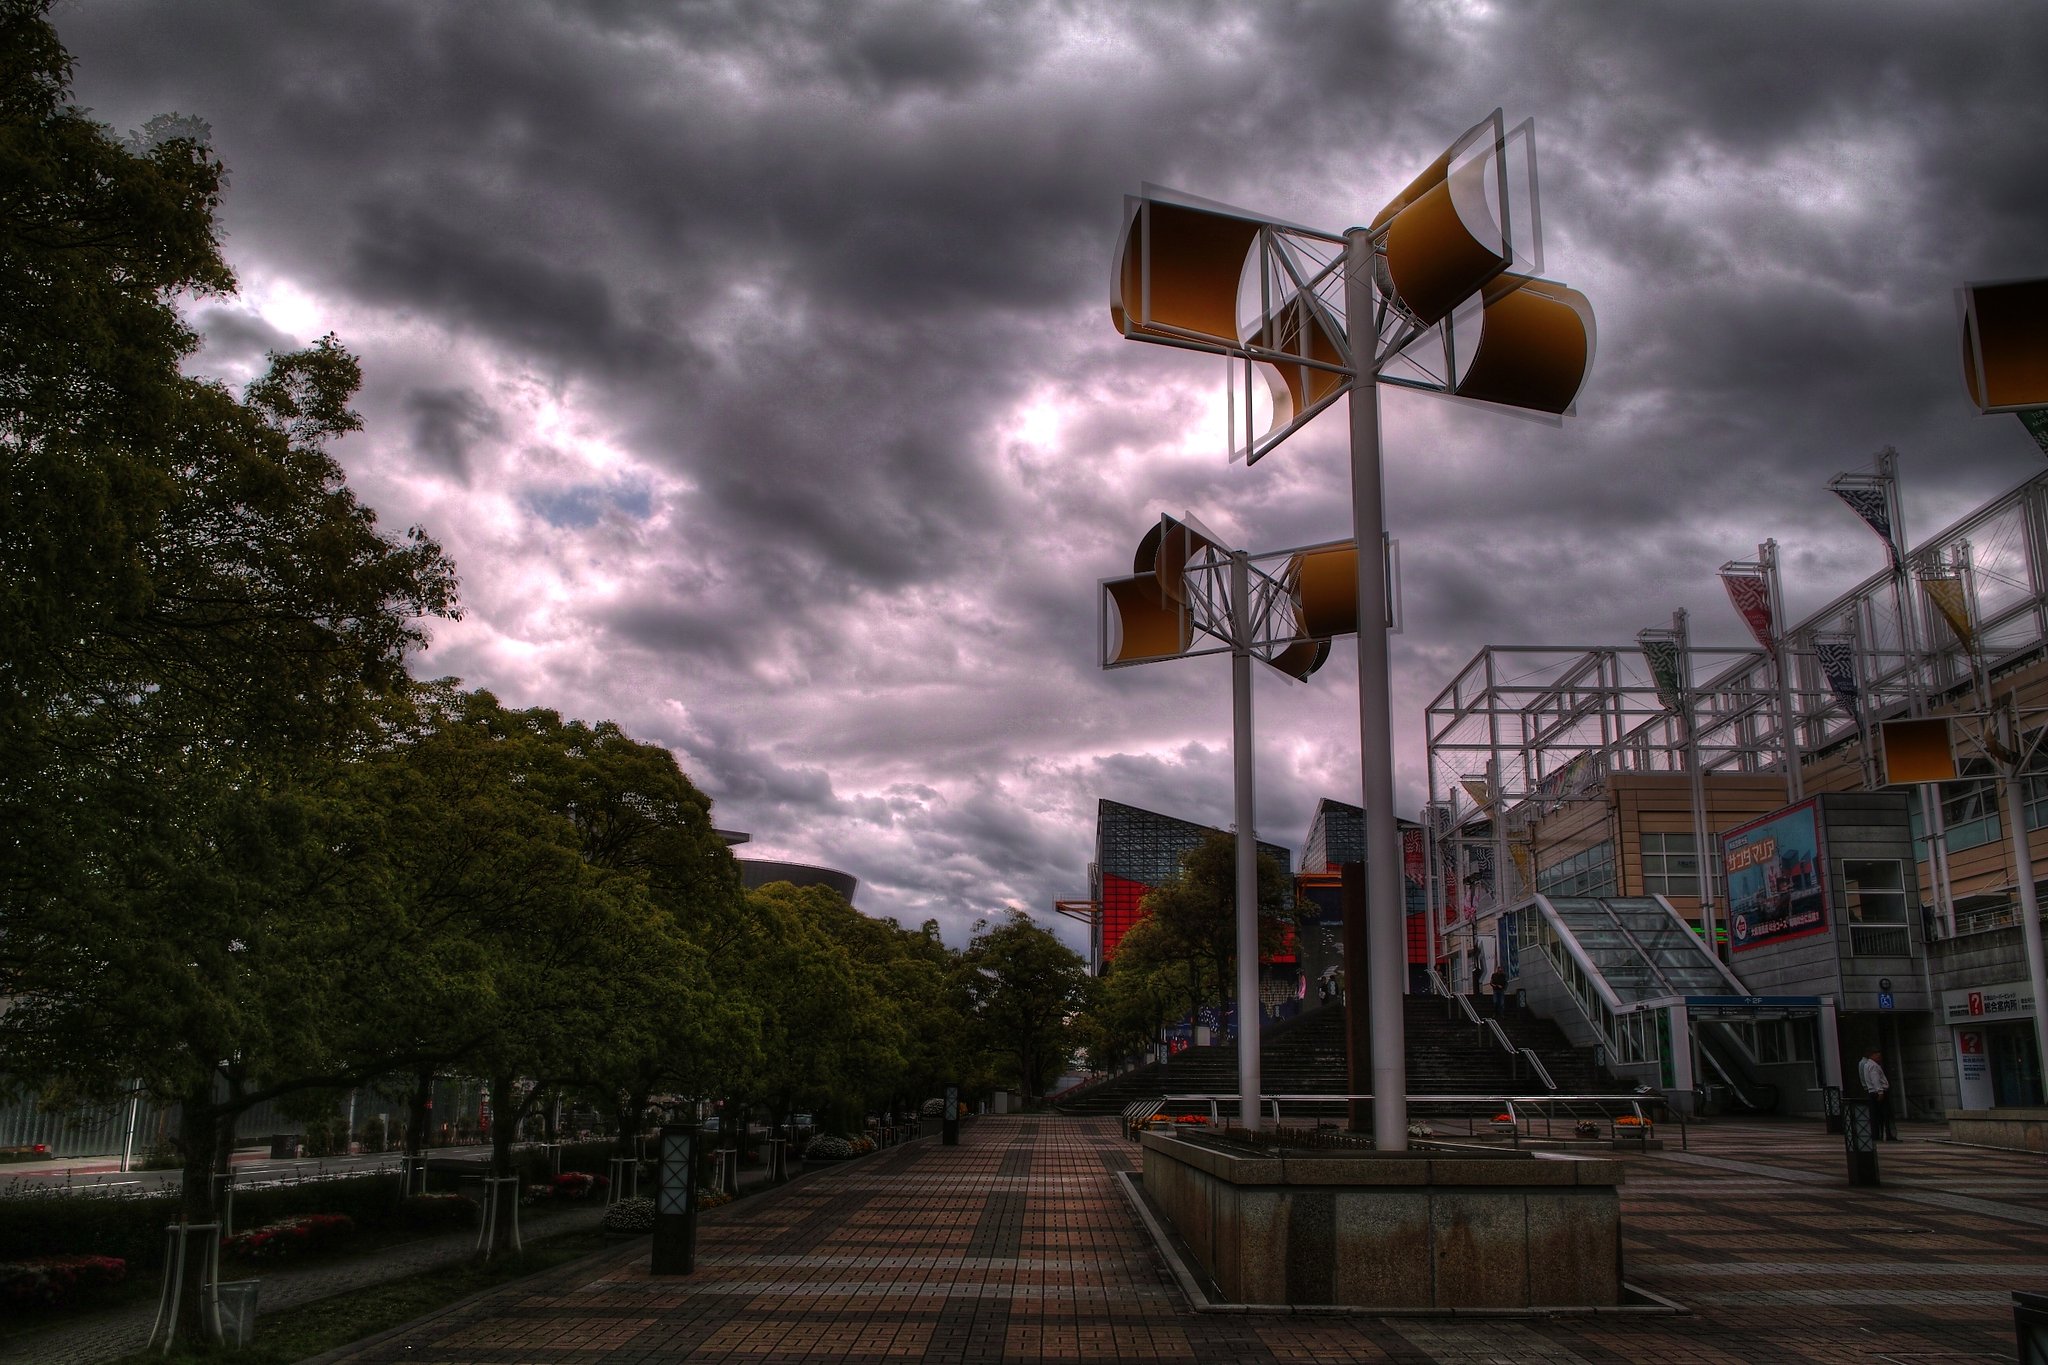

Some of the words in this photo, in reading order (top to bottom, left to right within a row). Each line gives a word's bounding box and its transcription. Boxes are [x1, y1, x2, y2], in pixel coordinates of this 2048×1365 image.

[1728, 839, 1775, 871] サンタマリア
